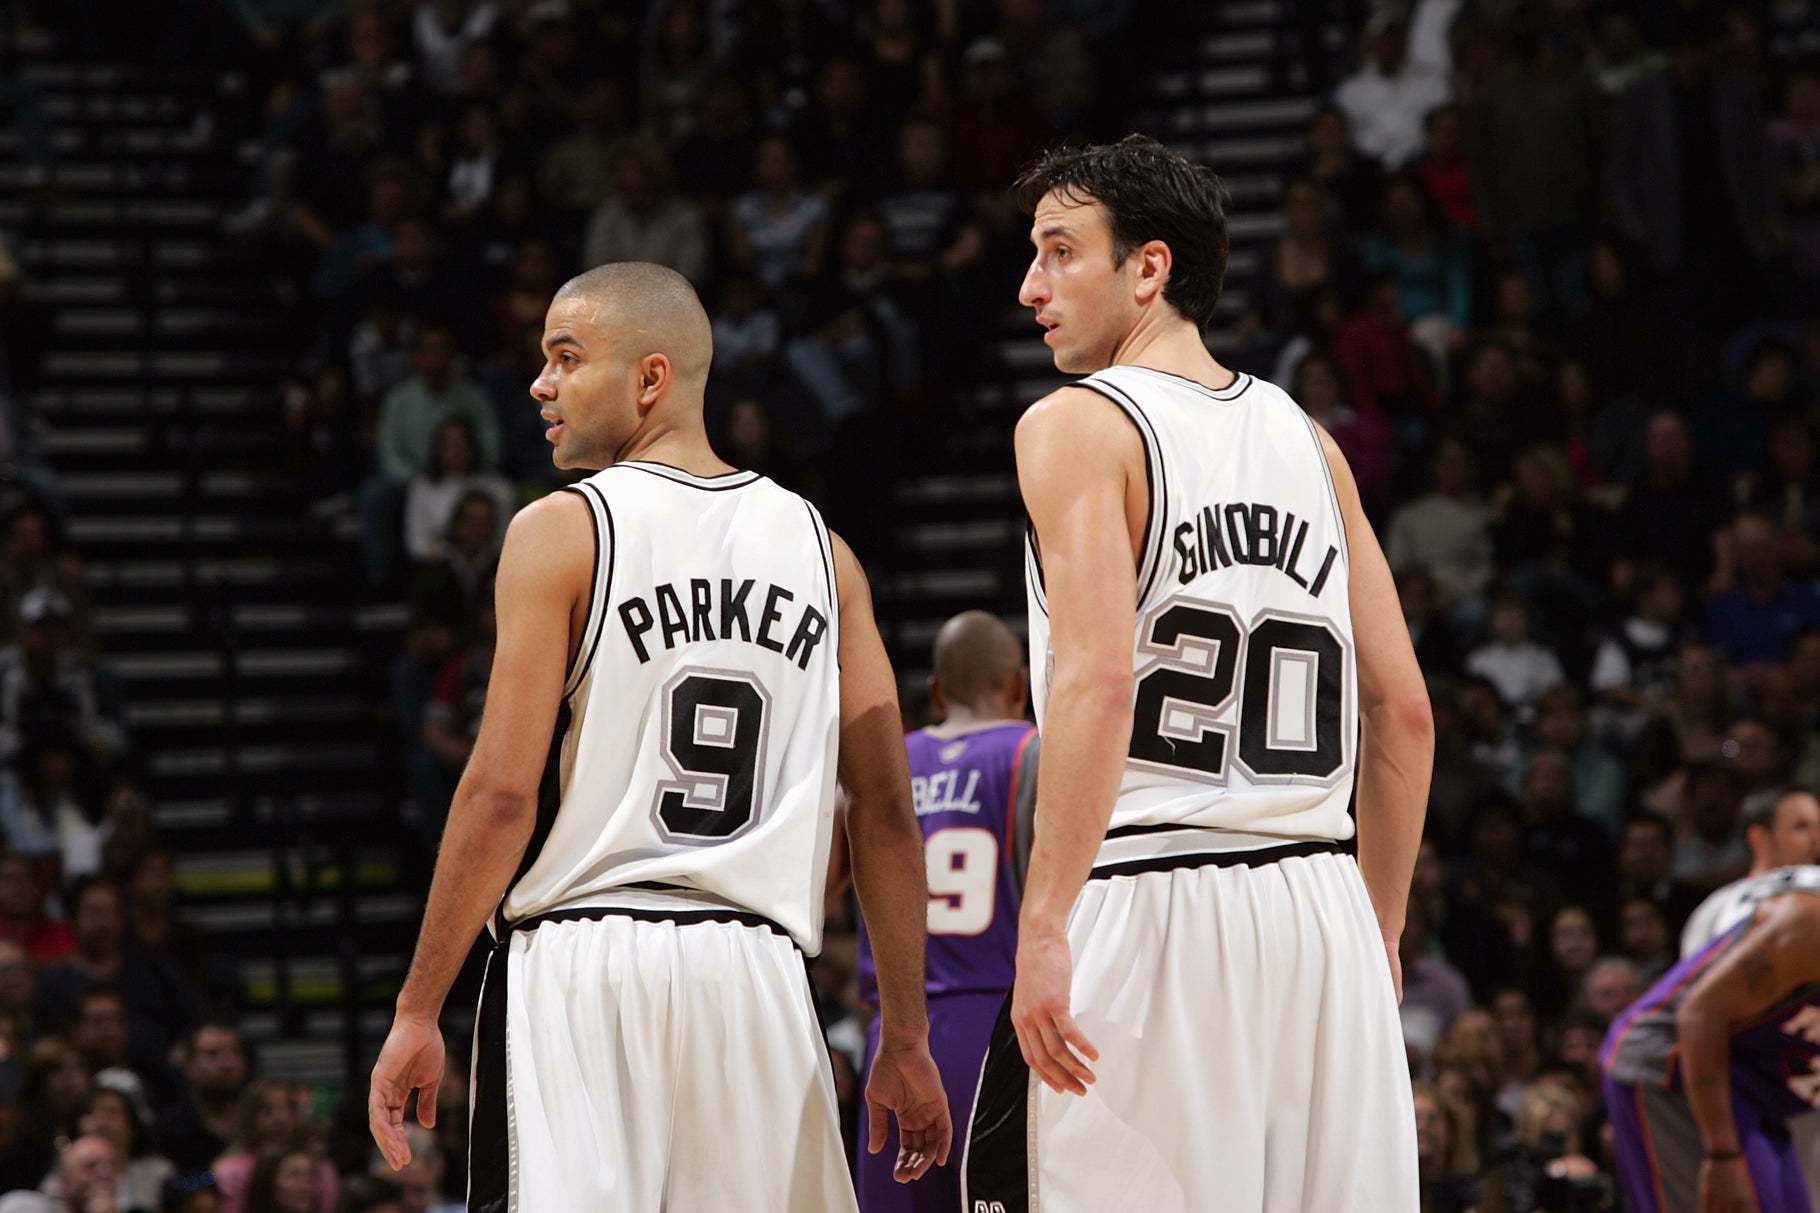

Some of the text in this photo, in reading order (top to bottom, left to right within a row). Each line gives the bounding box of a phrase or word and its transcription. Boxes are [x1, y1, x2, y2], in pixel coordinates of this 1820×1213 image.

[1173, 502, 1338, 598] GINOBILI
[617, 578, 828, 672] PARKER
[1127, 594, 1352, 788] 20
[649, 665, 773, 848] 9
[911, 768, 981, 817] BELL
